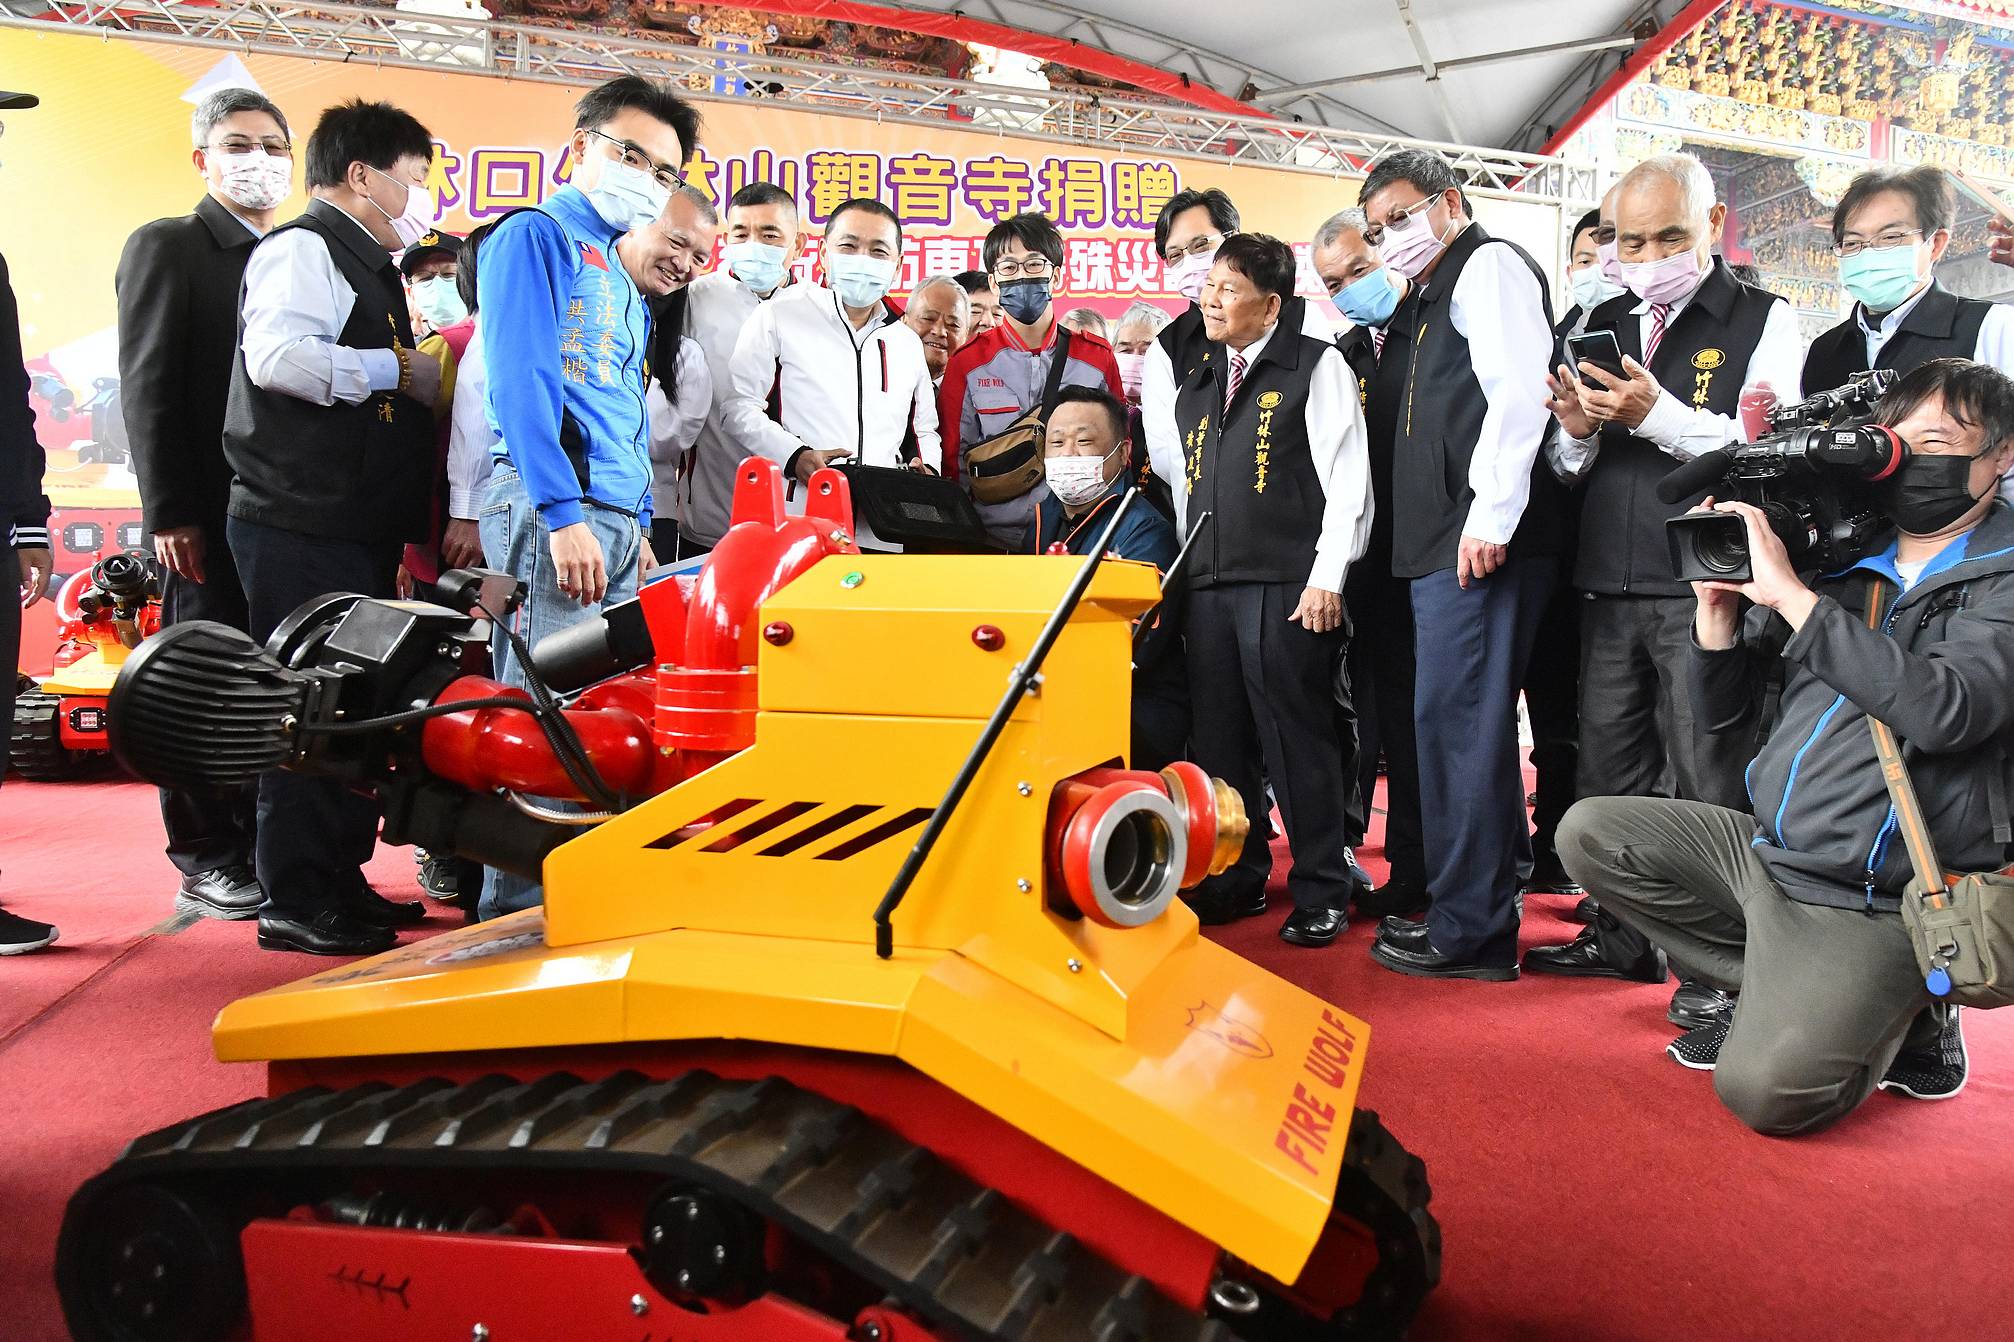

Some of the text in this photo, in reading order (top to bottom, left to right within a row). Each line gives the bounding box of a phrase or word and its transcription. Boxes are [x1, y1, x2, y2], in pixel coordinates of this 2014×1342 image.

[591, 273, 618, 388] 立法委員
[1692, 370, 1713, 413] 竹林
[1254, 410, 1274, 494] 竹林山觀音寺
[1274, 1008, 1357, 1176] FIRE WOLF
